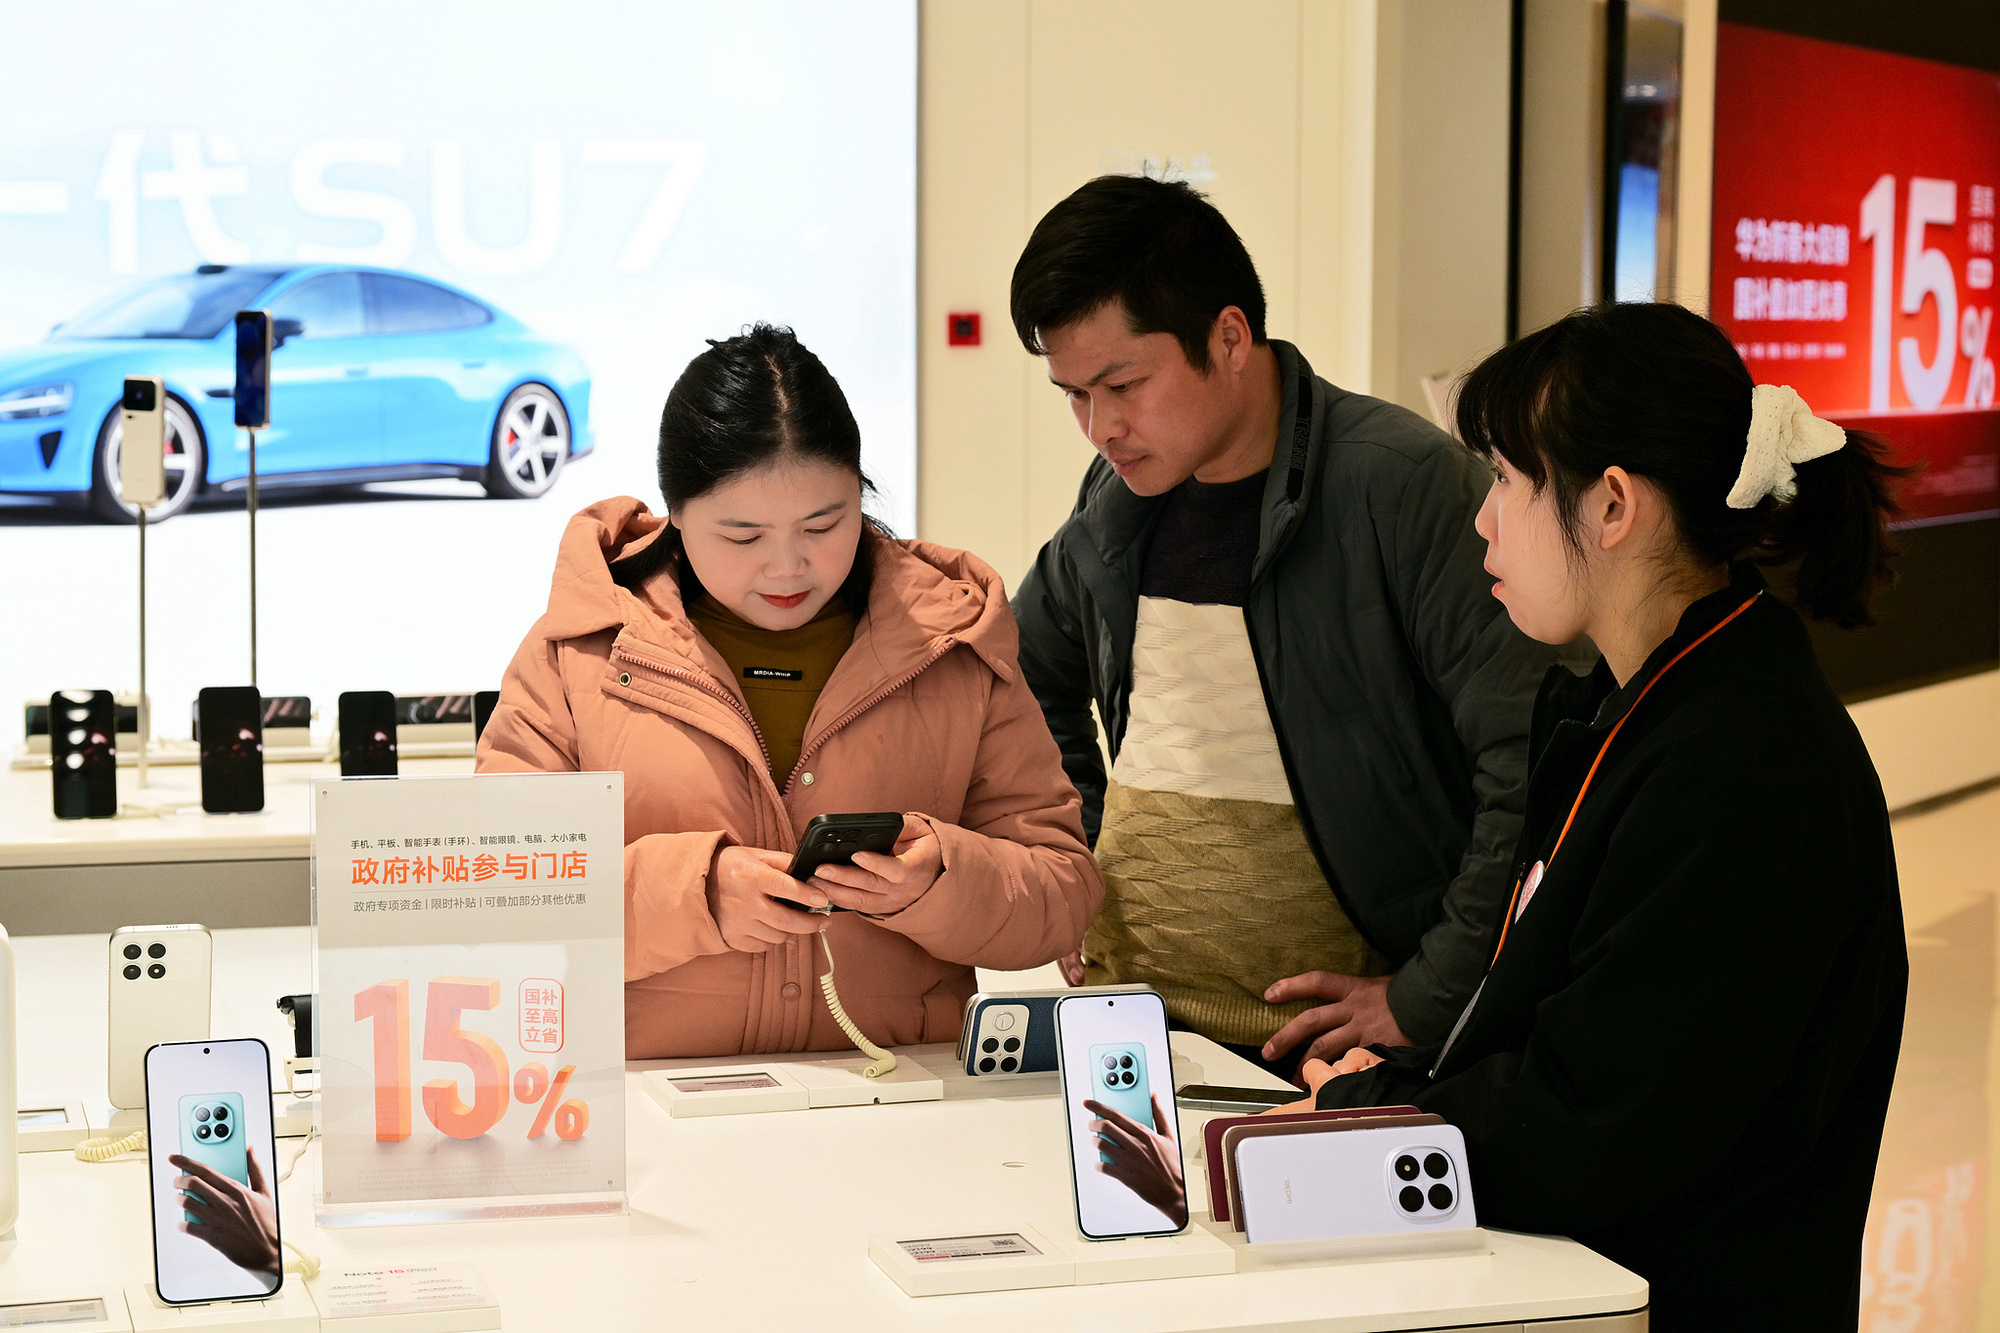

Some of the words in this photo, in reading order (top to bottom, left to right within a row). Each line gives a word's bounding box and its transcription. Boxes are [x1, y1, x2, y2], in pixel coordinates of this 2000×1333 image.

[289, 136, 710, 274] SU7
[1859, 174, 1996, 414] 15%
[352, 850, 587, 885] 政府补贴参与门店
[525, 988, 558, 1005] 国补
[525, 1008, 558, 1024] 至高
[525, 1026, 558, 1044] 立省
[353, 975, 590, 1142] 15%
